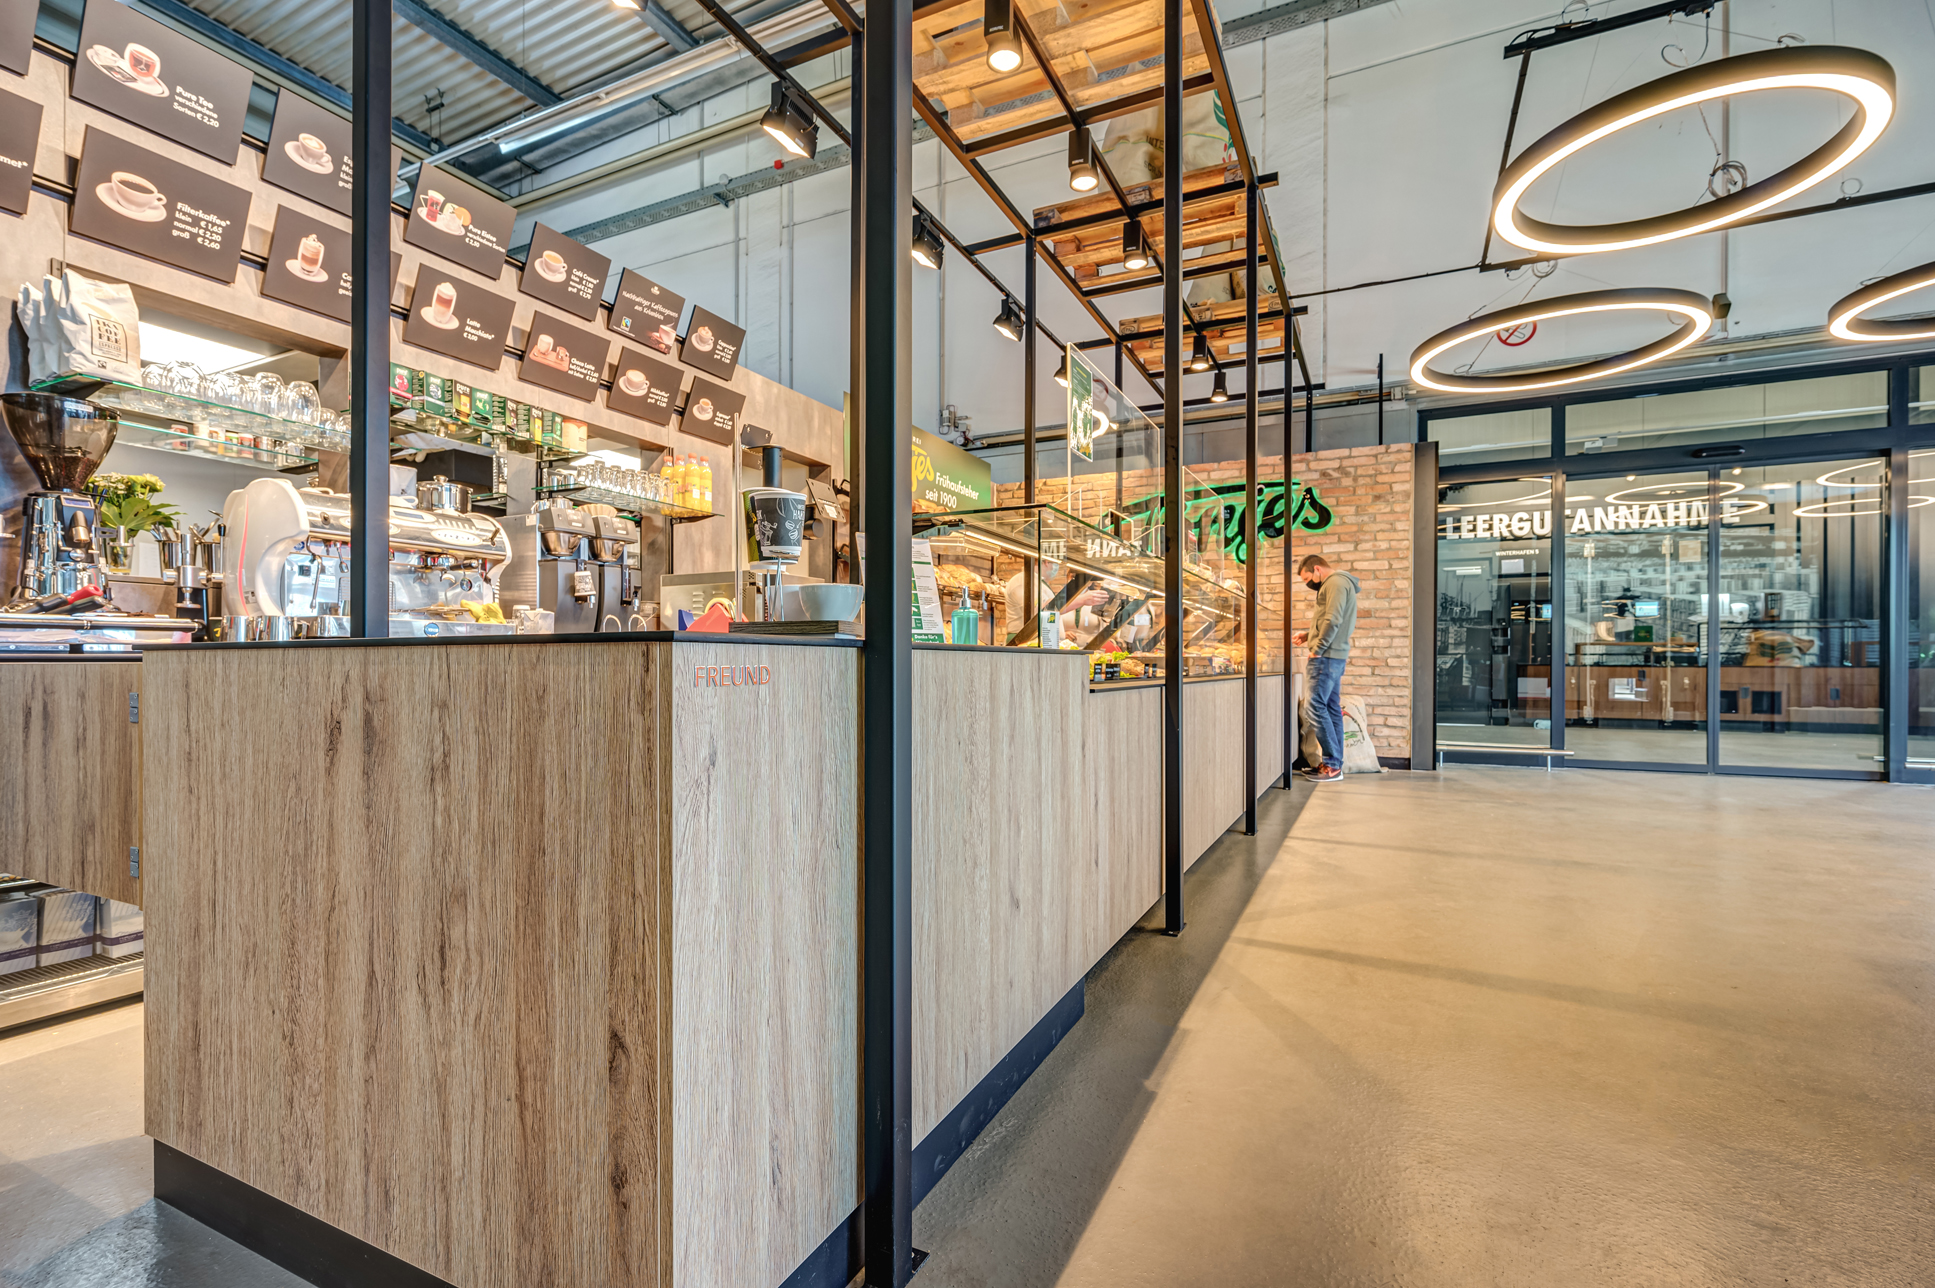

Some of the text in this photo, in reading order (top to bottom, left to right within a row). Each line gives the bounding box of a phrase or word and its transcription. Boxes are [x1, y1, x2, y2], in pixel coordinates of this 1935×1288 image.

[174, 95, 218, 119] verschiedene
[176, 85, 214, 109] Pure Tee
[172, 102, 196, 117] Sorten
[173, 220, 199, 234] normal
[175, 210, 192, 223] klein
[936, 471, 979, 500] Frühaufsteher
[925, 488, 957, 509] seit 1900
[1495, 549, 1534, 557] WINTERHAFEN
[694, 664, 771, 688] FREUND
